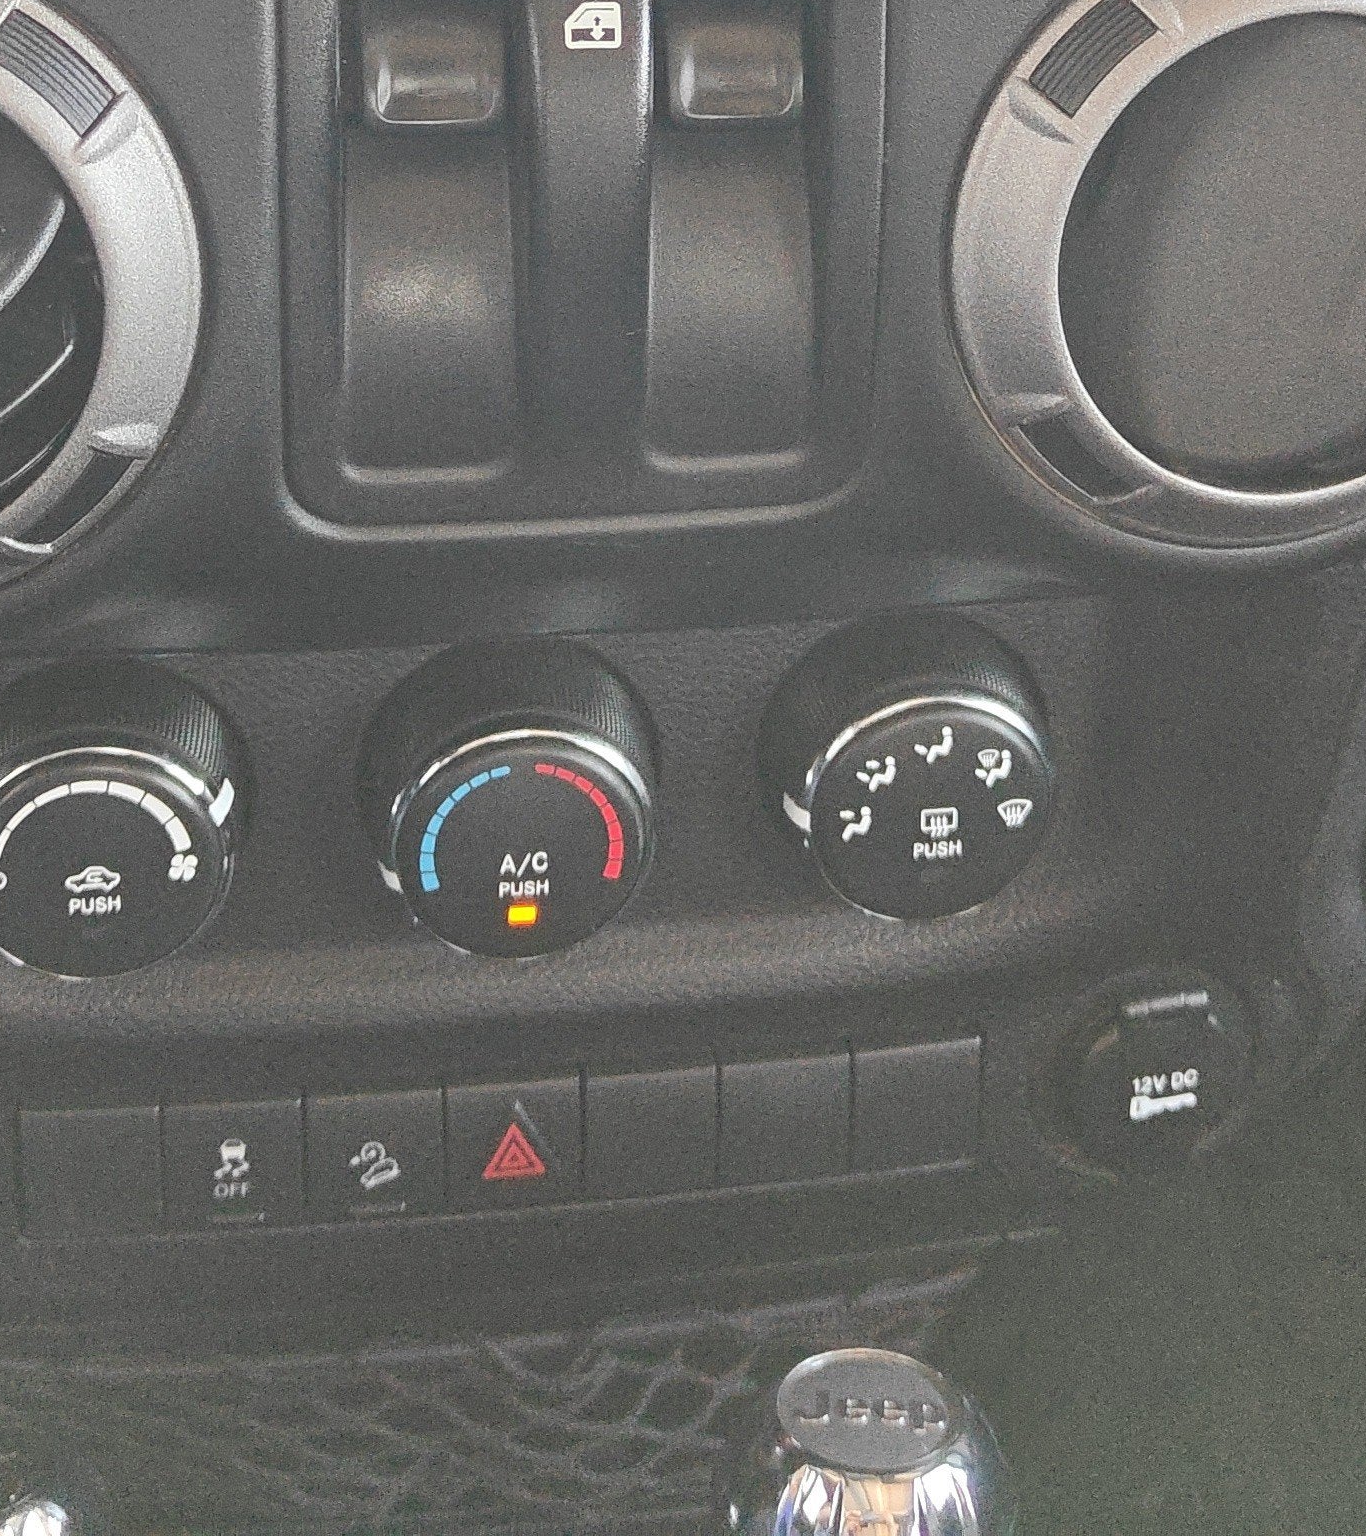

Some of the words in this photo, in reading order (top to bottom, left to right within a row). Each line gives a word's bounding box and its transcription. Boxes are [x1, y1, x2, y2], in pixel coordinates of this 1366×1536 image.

[913, 840, 963, 860] PUSH
[500, 851, 549, 877] A/C
[498, 879, 550, 898] PUSH
[68, 894, 122, 915] PUSH
[1132, 1074, 1167, 1096] 12V
[1171, 1068, 1199, 1092] DC
[799, 1389, 946, 1436] Jeep
